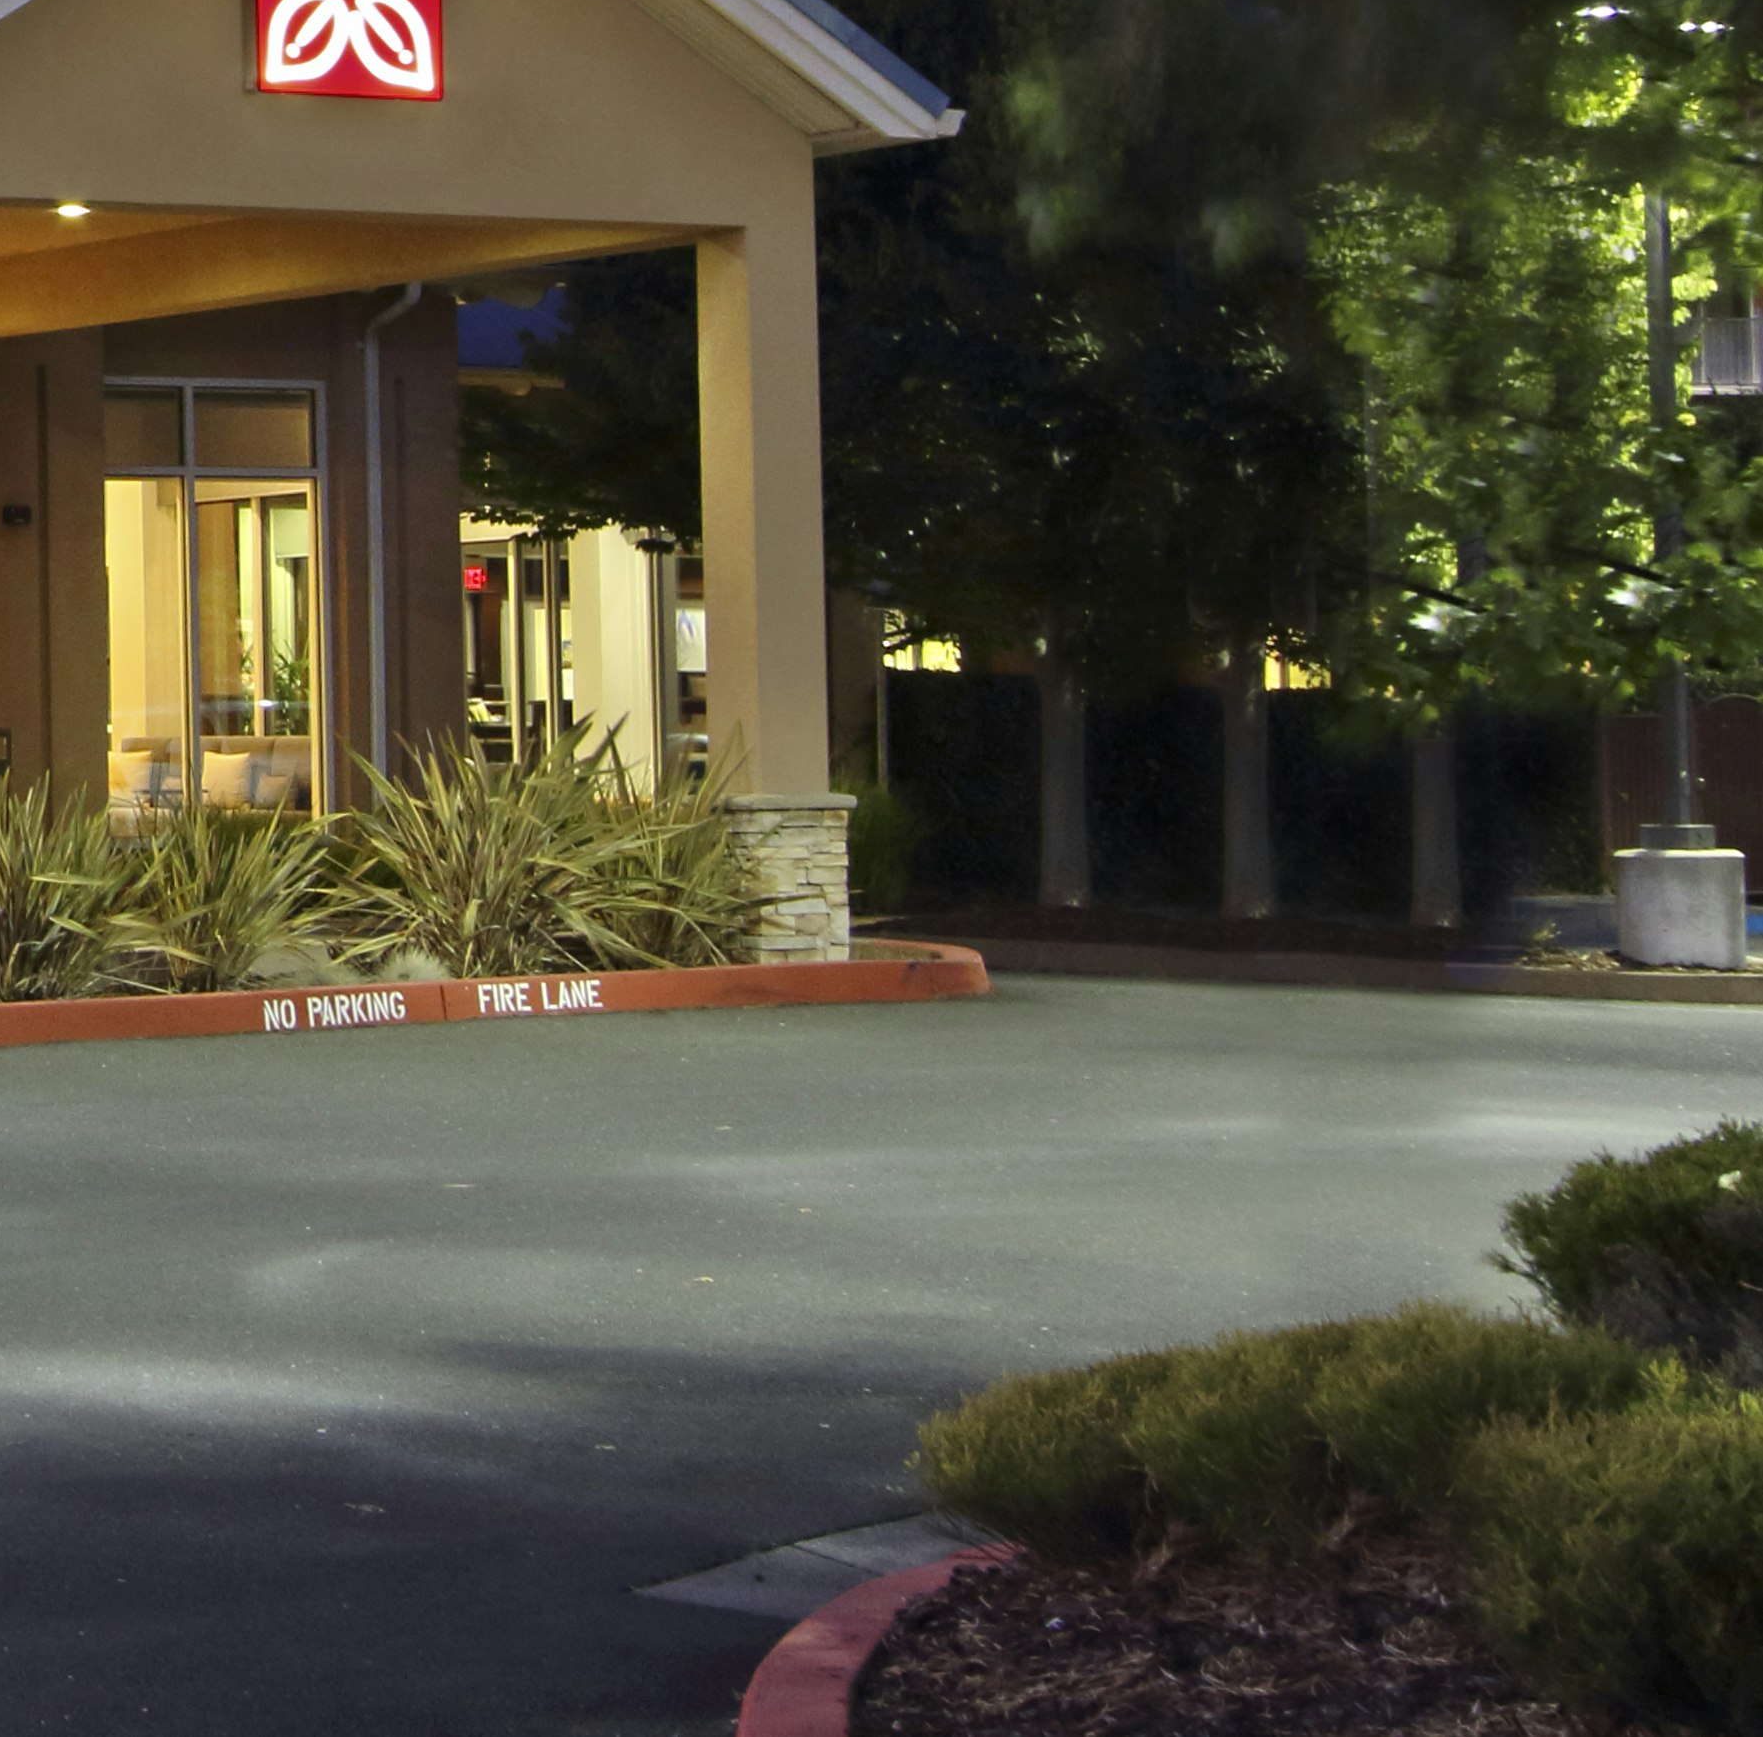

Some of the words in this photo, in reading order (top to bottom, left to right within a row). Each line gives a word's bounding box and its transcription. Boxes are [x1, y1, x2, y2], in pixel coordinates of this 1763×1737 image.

[263, 998, 297, 1031] NO
[307, 991, 406, 1029] PARKING
[477, 982, 532, 1014] FIRE
[541, 979, 603, 1011] LANE
